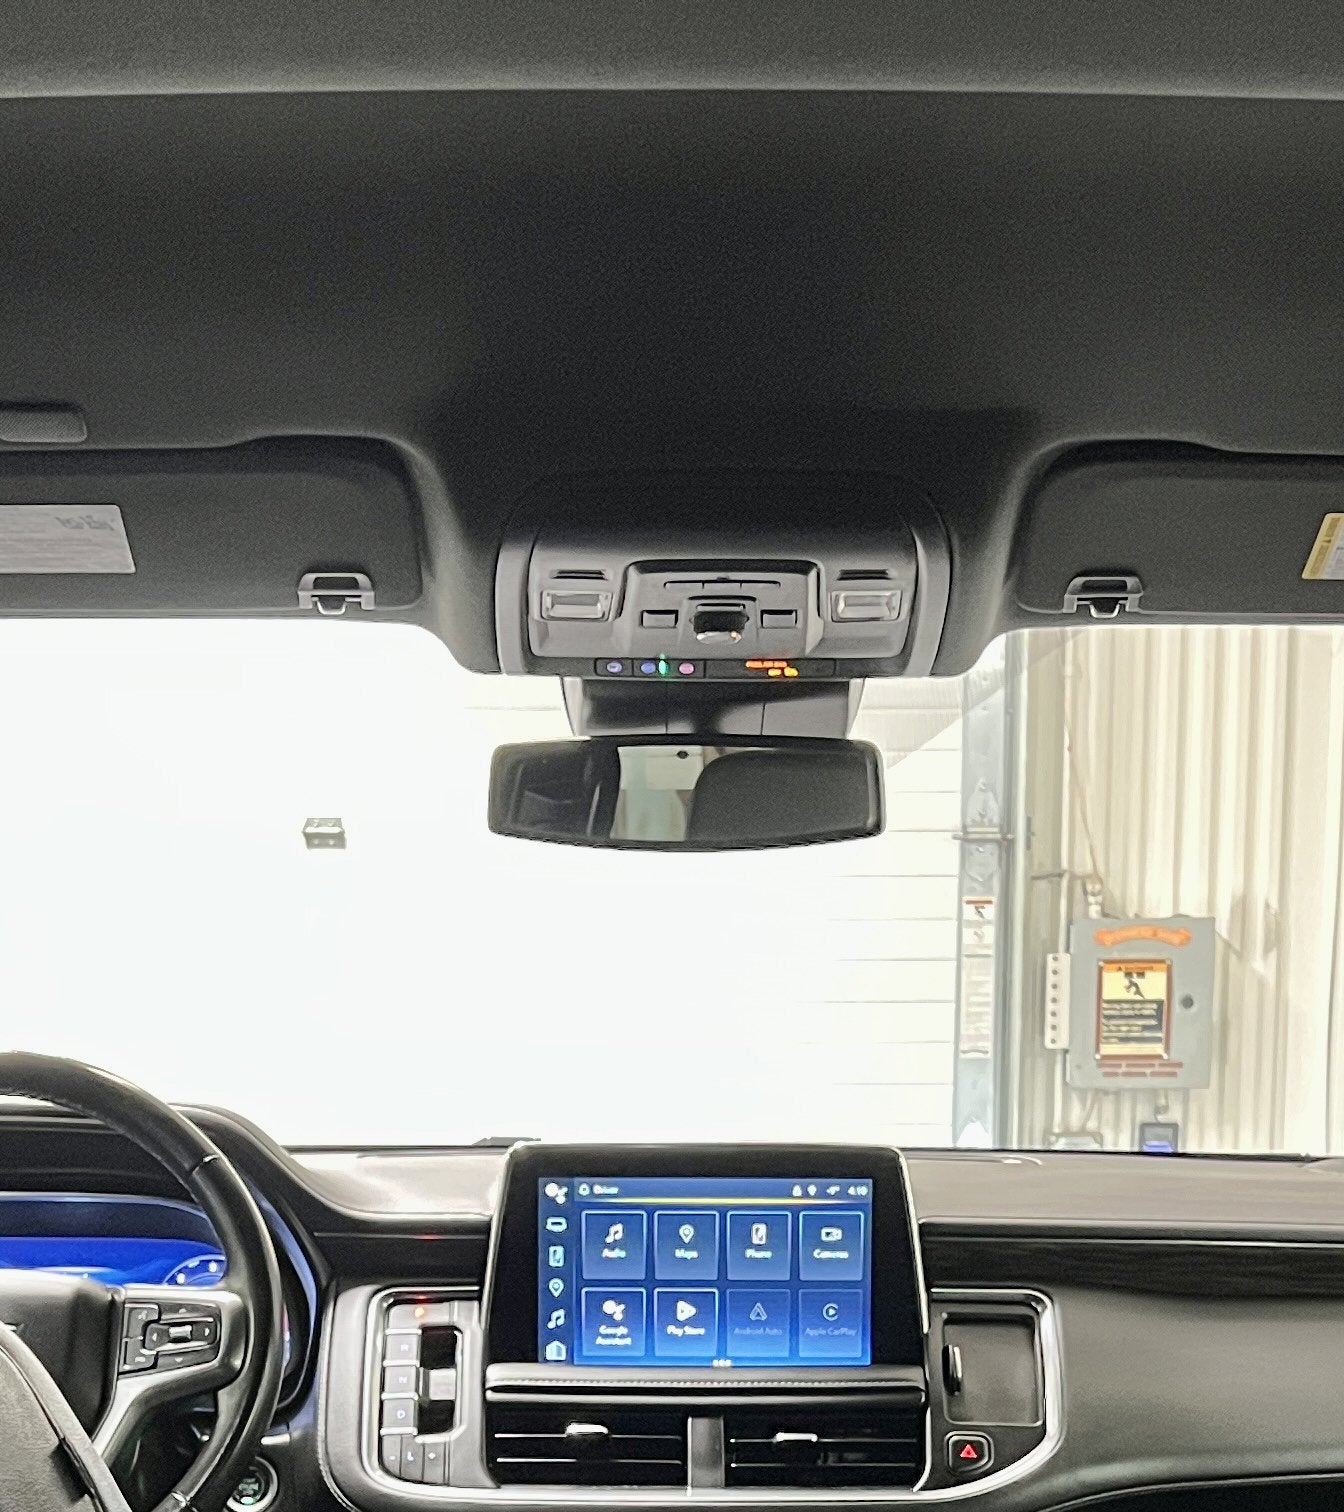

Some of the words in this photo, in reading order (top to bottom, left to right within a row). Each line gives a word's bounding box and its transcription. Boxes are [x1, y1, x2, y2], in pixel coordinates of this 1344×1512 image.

[733, 1327, 764, 1336] Android
[765, 1327, 783, 1336] Auto
[805, 1327, 826, 1337] Apple
[827, 1327, 858, 1337] CarPlay
